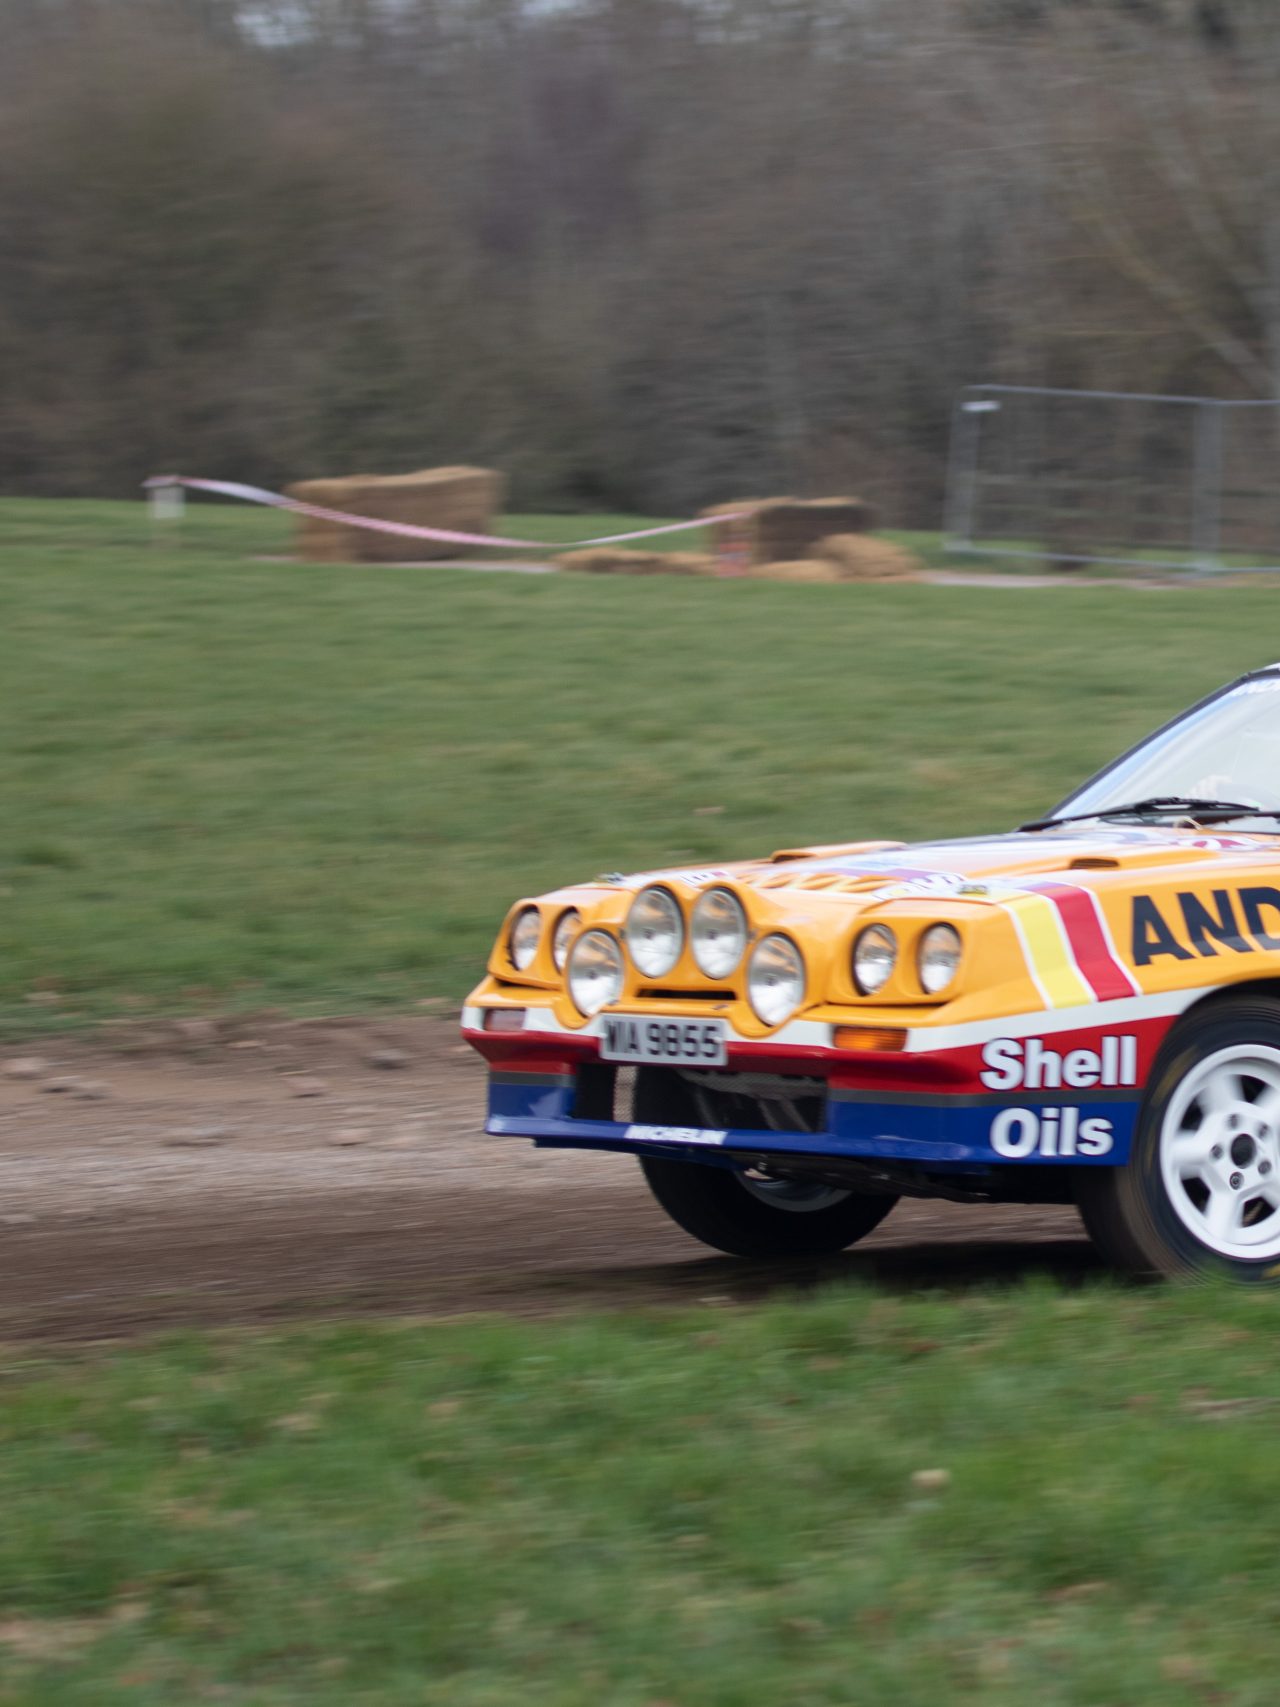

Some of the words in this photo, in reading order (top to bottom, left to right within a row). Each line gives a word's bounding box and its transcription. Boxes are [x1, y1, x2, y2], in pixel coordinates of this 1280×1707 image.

[646, 1022, 719, 1059] 9855
[978, 1036, 1138, 1091] Shell
[989, 1105, 1114, 1159] Oils
